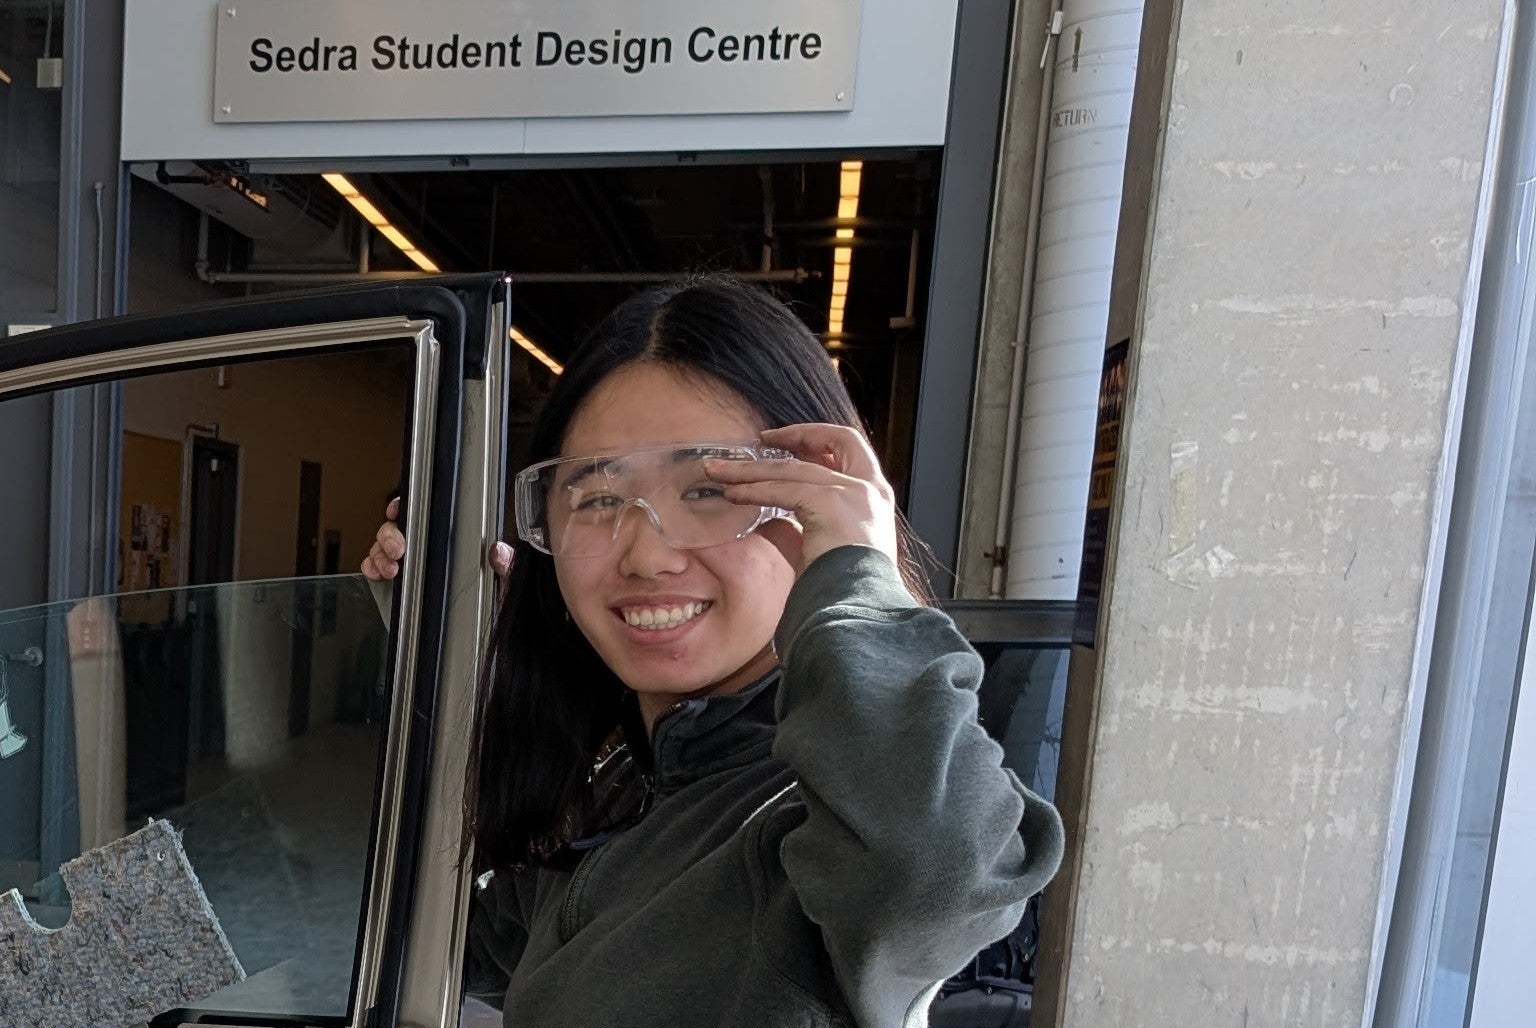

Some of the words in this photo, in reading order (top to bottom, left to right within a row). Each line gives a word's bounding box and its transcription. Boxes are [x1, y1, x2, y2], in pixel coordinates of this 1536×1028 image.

[249, 37, 358, 73] Sedra
[371, 34, 522, 70] Student
[535, 29, 672, 74] Design
[687, 26, 822, 62] Centre
